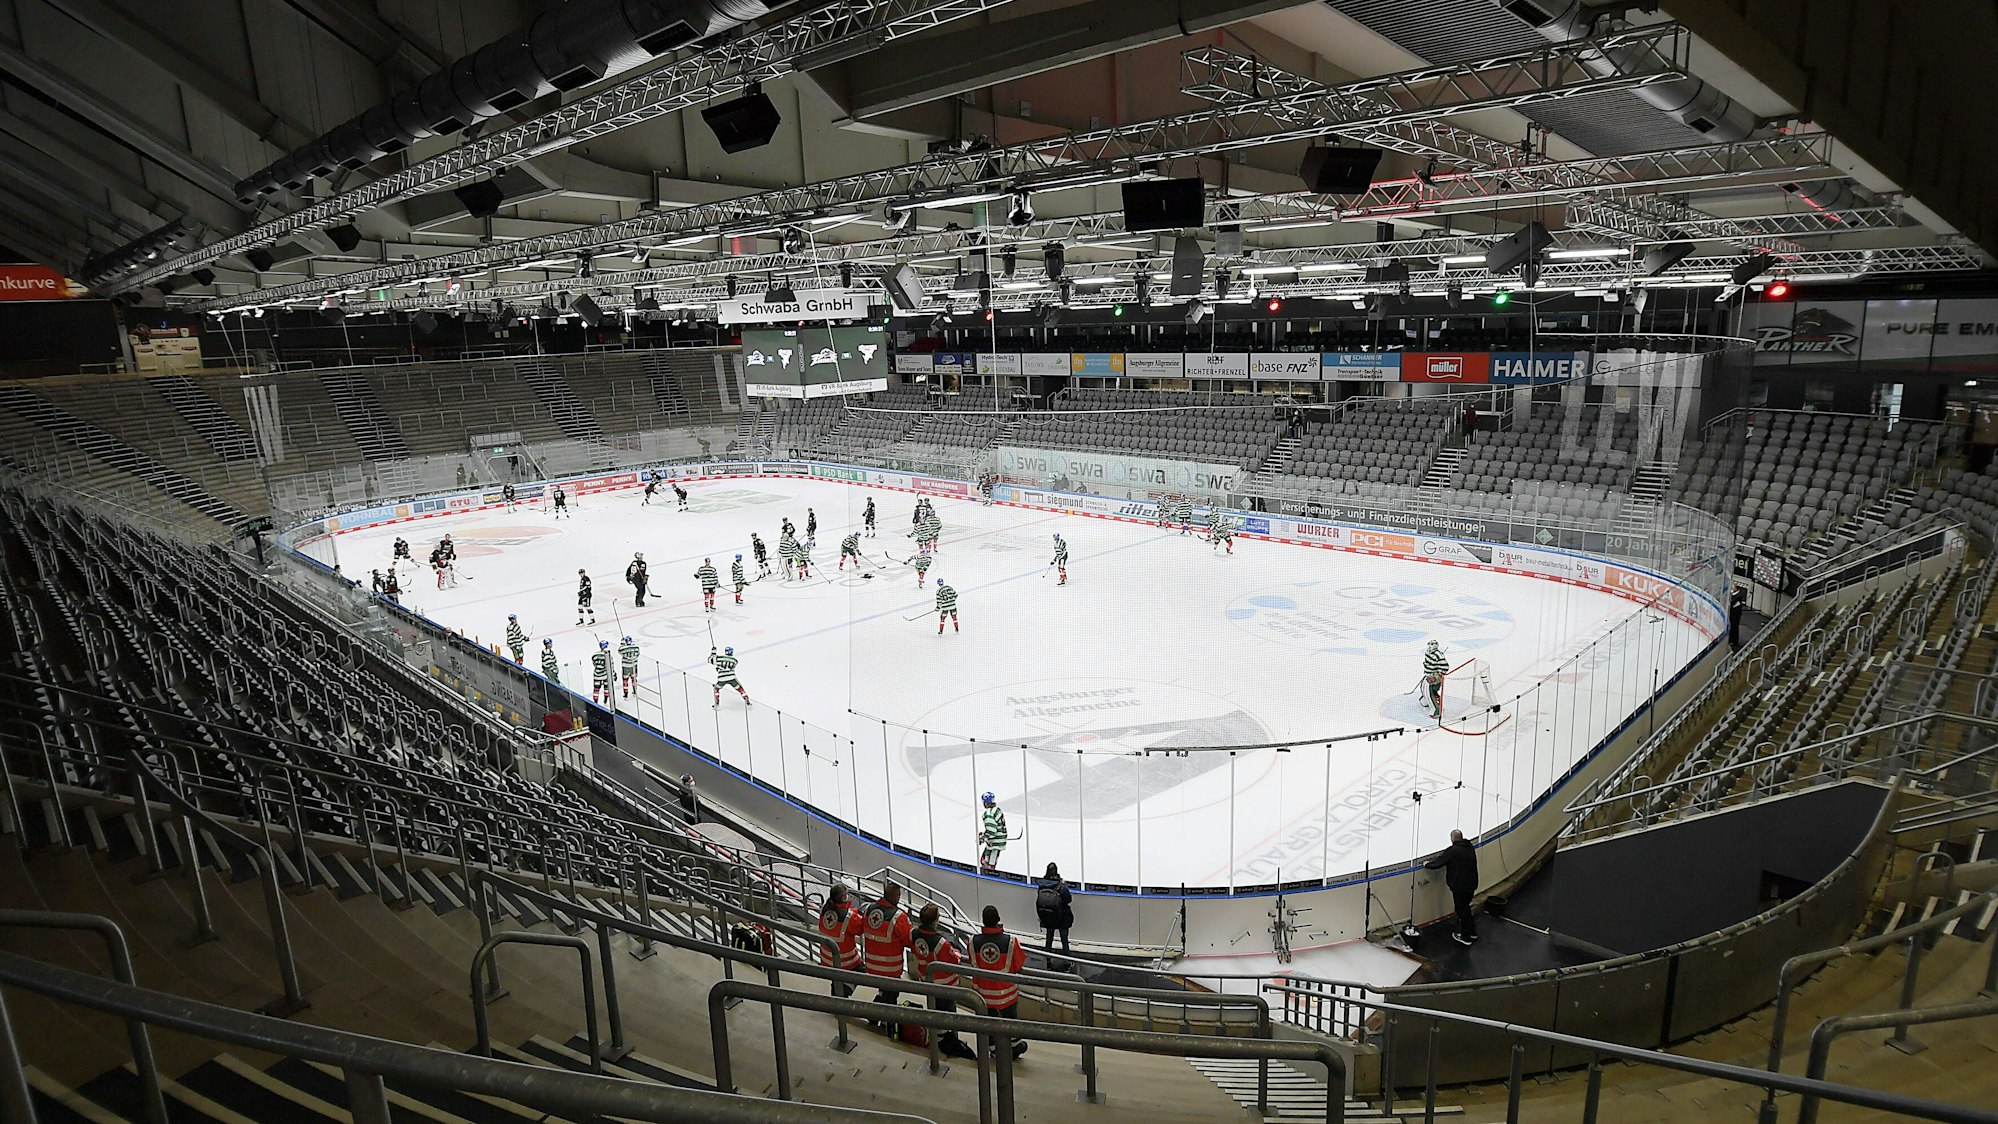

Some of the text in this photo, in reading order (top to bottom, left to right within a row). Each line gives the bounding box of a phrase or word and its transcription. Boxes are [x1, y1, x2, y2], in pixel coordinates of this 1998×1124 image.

[741, 298, 853, 315] Schwaba GmbH
[1887, 322, 1949, 336] PURE
[1756, 326, 1859, 356] PANTHER
[1251, 359, 1308, 374] ebase FNZ
[1431, 357, 1458, 373] müller
[1494, 359, 1585, 379] HAIMER
[1017, 455, 1233, 491] swa swa swa swa
[1046, 494, 1084, 508] siegmund
[1281, 501, 1486, 533] Versicherungs- und Finanzdienstleistungen
[1297, 523, 1340, 538] WURZER
[1438, 546, 1462, 555] GRAF
[1607, 536, 1622, 548] 20
[1618, 572, 1674, 603] KUKA
[1006, 687, 1135, 706] Augsburger
[1013, 699, 1142, 719] Allgemeine
[1313, 769, 1408, 825] CAROLA
[1228, 825, 1323, 881] GRAUL
